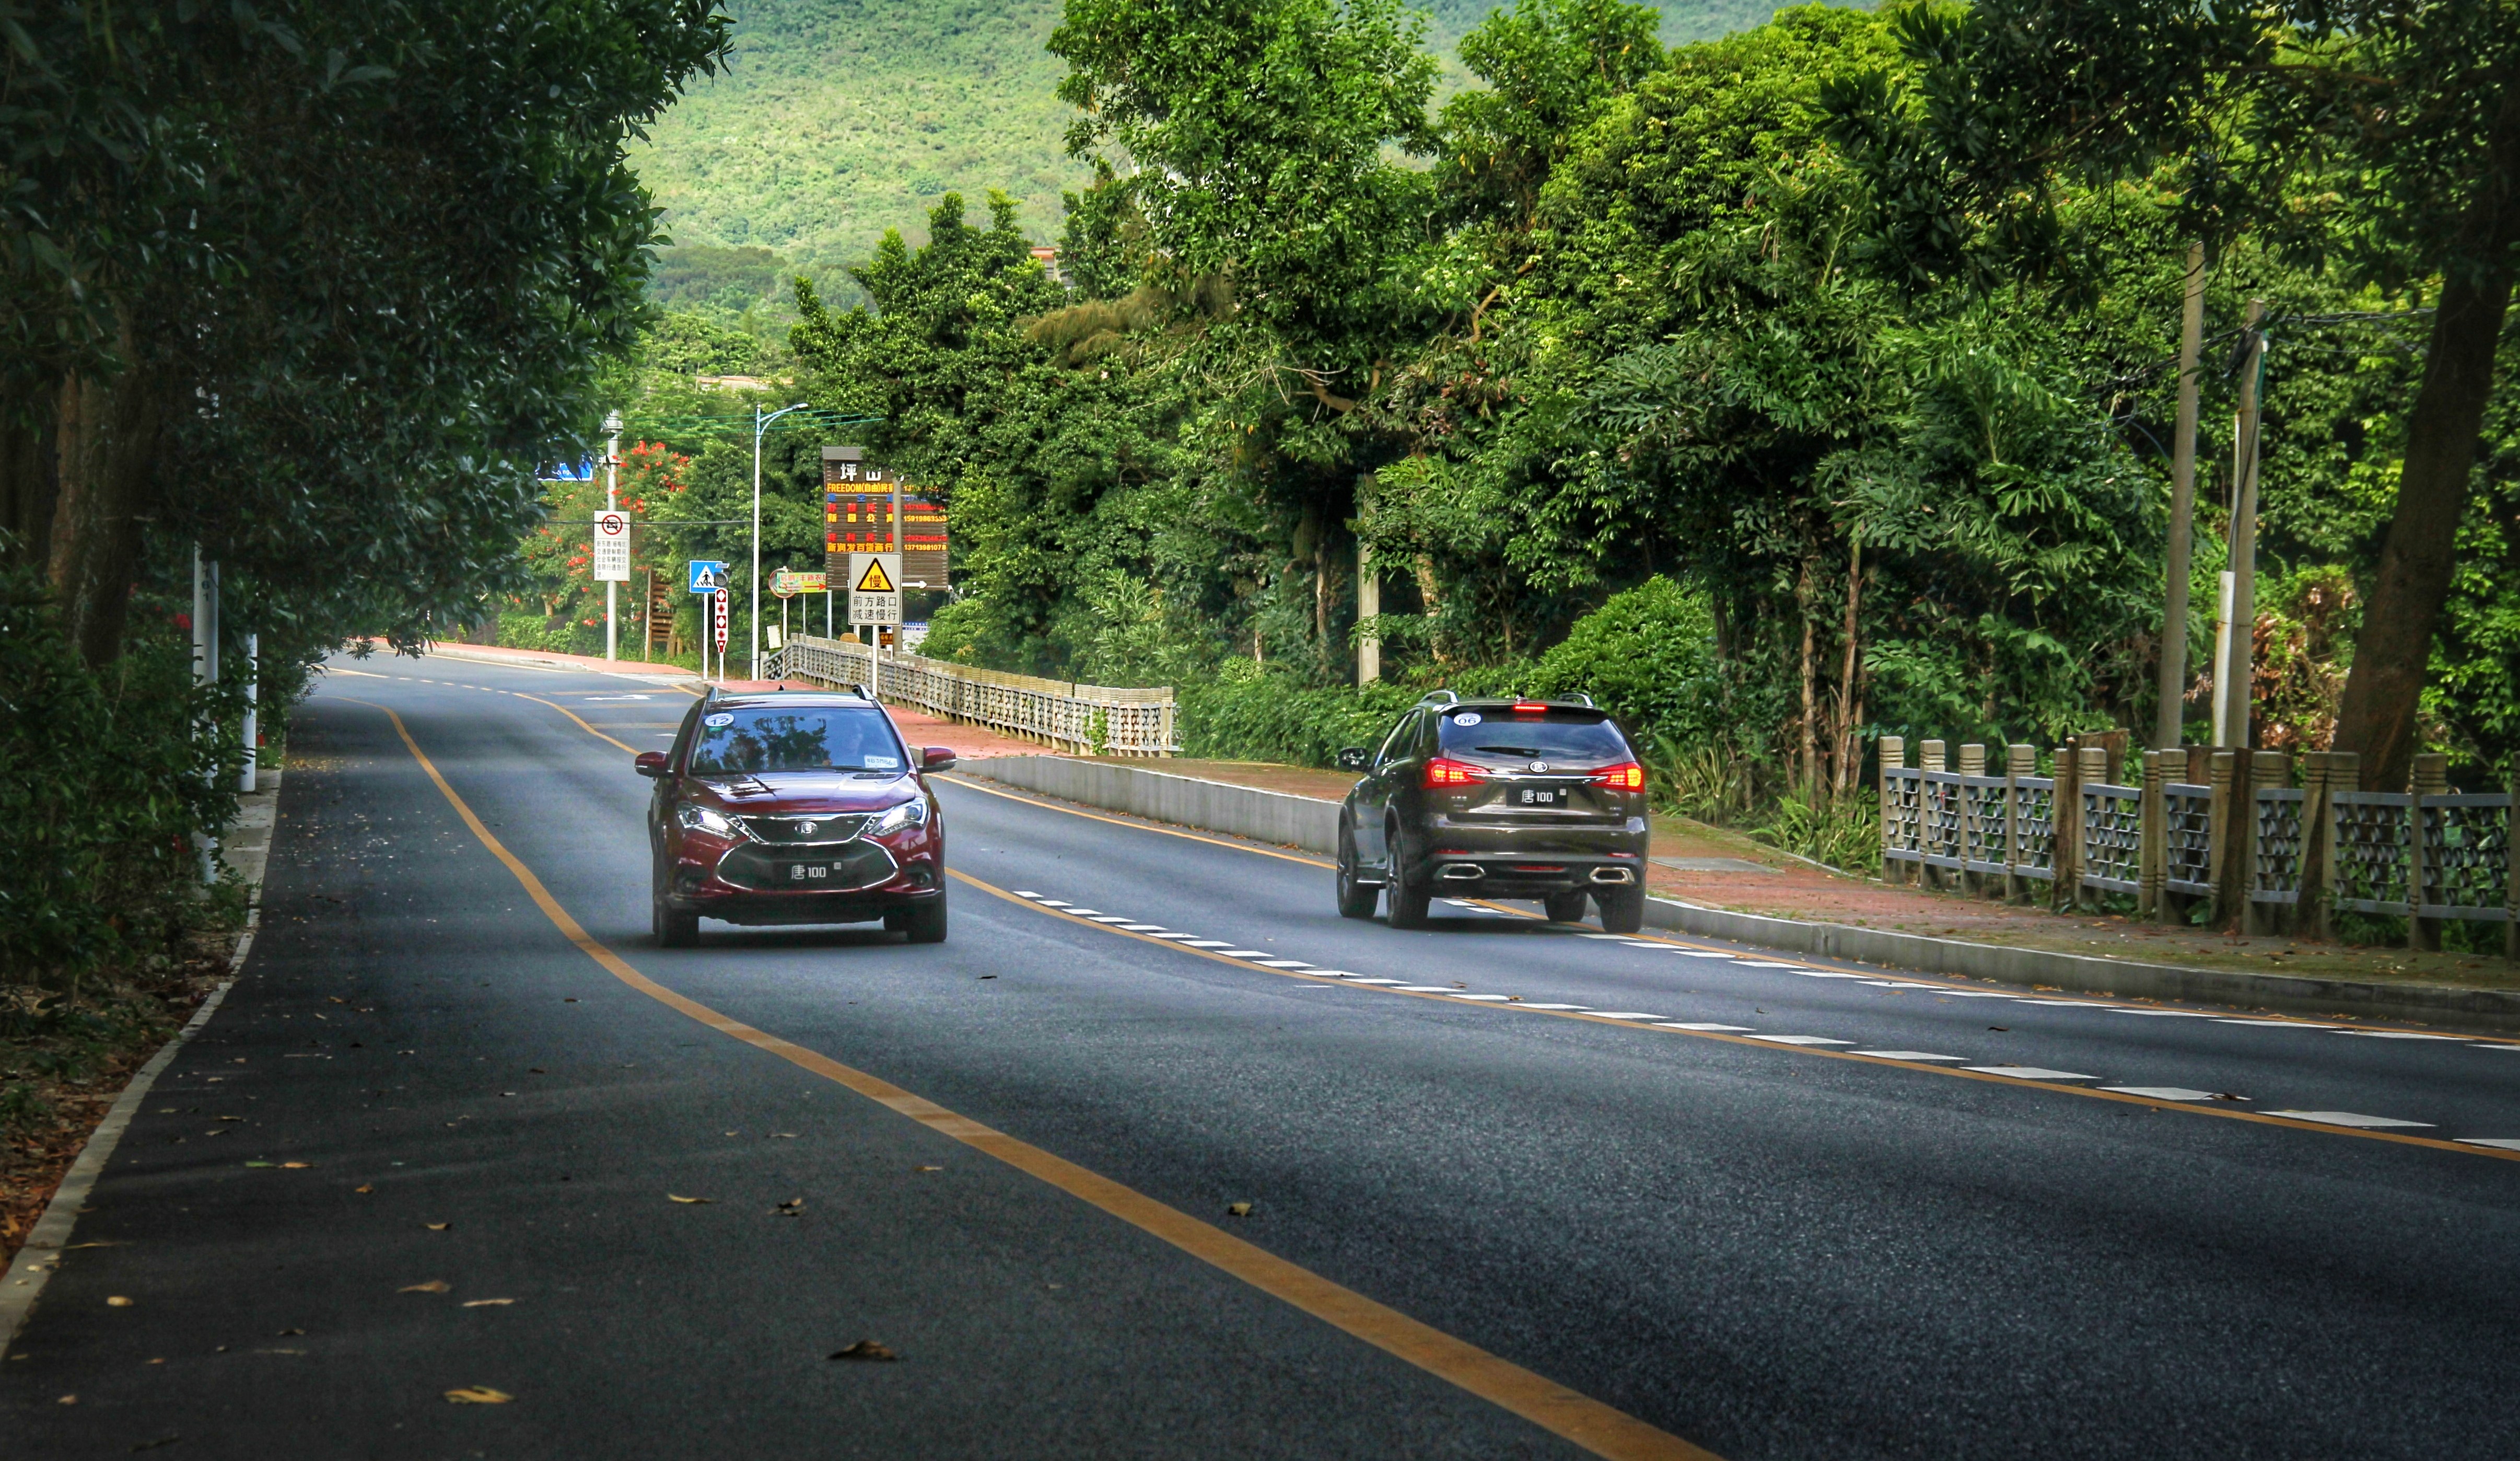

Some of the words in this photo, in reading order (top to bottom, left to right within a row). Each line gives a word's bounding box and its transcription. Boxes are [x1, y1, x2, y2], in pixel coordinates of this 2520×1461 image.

[869, 575, 881, 588] 慢
[853, 596, 896, 607] 前方路口
[853, 609, 897, 621] 减速慢行
[1522, 790, 1534, 803] 唐
[1536, 792, 1553, 802] 100
[791, 864, 806, 879] 唐
[808, 867, 826, 878] 100
